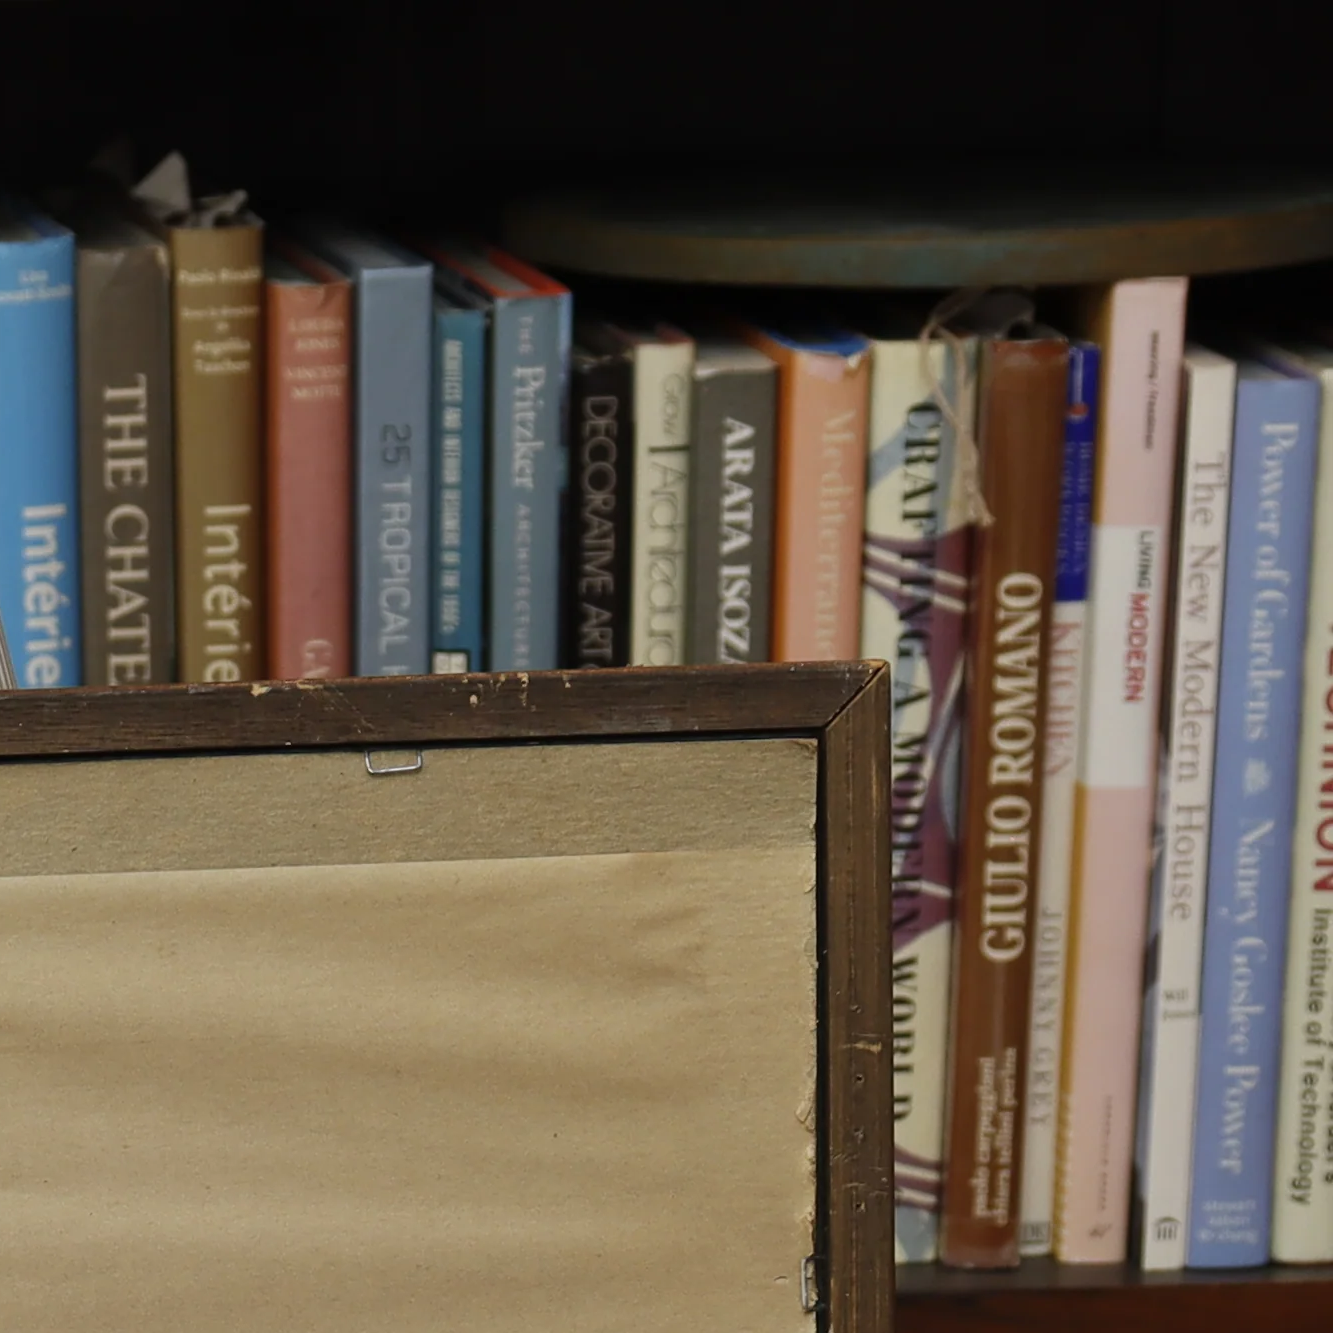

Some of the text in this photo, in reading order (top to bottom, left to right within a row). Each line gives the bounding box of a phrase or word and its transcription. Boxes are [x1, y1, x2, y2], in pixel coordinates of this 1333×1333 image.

[518, 315, 534, 354] THE
[102, 372, 150, 492] THE
[379, 422, 412, 467] 25
[511, 363, 547, 489] Pritzker
[579, 395, 618, 596] DECORATIVE
[720, 416, 755, 556] ARATA
[20, 502, 71, 686] Intérie
[378, 474, 413, 655] TROPICAL
[895, 400, 942, 659] CRAFTING
[1242, 421, 1300, 744] Power of Gardens
[579, 600, 614, 662] ART
[1124, 529, 1156, 704] LIVING MODERN
[1167, 450, 1229, 923] The New Modern House
[979, 571, 1044, 964] GIULIO ROMANO
[1043, 620, 1081, 777] KITCHEN
[1218, 817, 1275, 923] Nancy
[1029, 906, 1063, 1125] JOHNNY GREY
[1305, 1021, 1328, 1047] of
[1306, 907, 1333, 1014] Institute
[1218, 1064, 1263, 1178] Power
[1289, 1056, 1326, 1206] Technology
